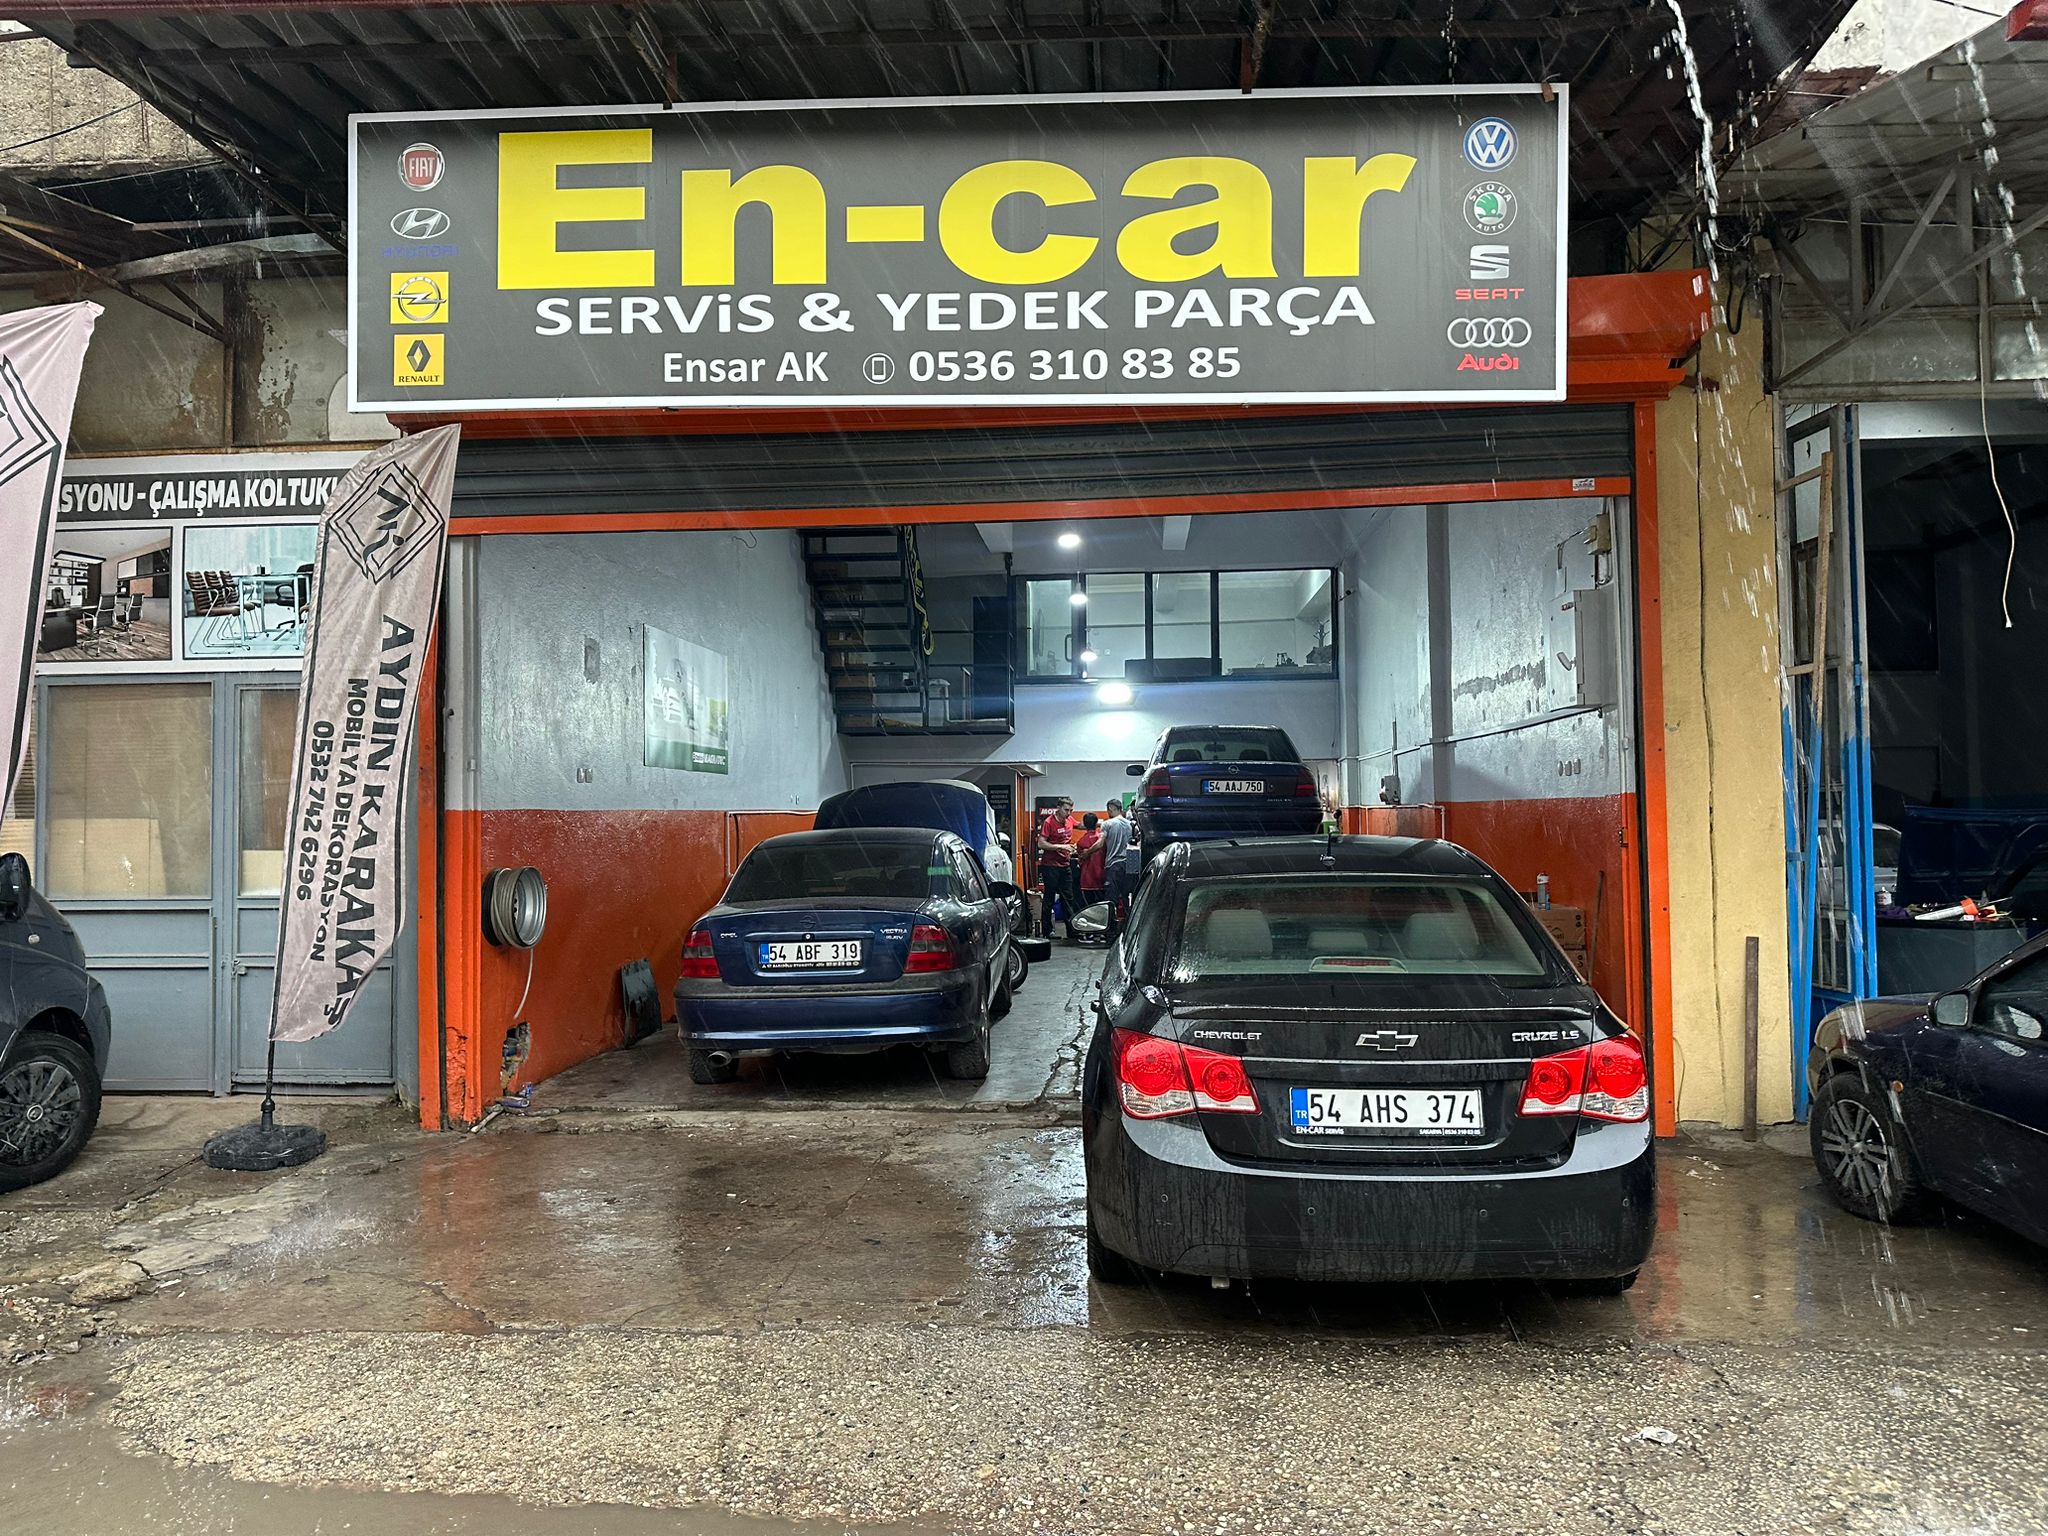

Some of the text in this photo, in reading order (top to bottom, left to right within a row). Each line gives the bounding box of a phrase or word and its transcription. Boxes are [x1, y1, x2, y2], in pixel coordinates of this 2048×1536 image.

[408, 157, 436, 178] FIAT
[1468, 183, 1513, 203] SKODA
[498, 127, 1417, 290] En-car
[1476, 223, 1505, 232] AUTO
[1455, 288, 1525, 300] SEAT
[798, 292, 855, 333] &
[876, 289, 1109, 332] YEDEK
[1134, 286, 1376, 336] PARÇA
[663, 346, 1241, 383] Ensar AK 0536 310 83 85
[1457, 352, 1519, 371] Audi
[398, 375, 440, 383] RENAULT
[58, 482, 134, 513] SYONU
[137, 491, 146, 500] -
[149, 479, 241, 518] ÇALIŞMA
[366, 614, 415, 771] AYDIN
[1209, 781, 1220, 791] 54
[1225, 781, 1242, 791] AAJ
[1245, 781, 1262, 792] 750
[296, 720, 335, 901] 0532 742 6296
[310, 678, 369, 962] MOBİLYA DEKORASYON
[769, 945, 786, 961] 54
[796, 944, 822, 960] ABF
[831, 943, 858, 959] 319
[1194, 1030, 1262, 1040] CHEVROLET
[1512, 1030, 1580, 1042] CRUZE LS
[1295, 1093, 1474, 1123] TR 54 AHS 374
[1296, 1125, 1324, 1134] EN-CAR
